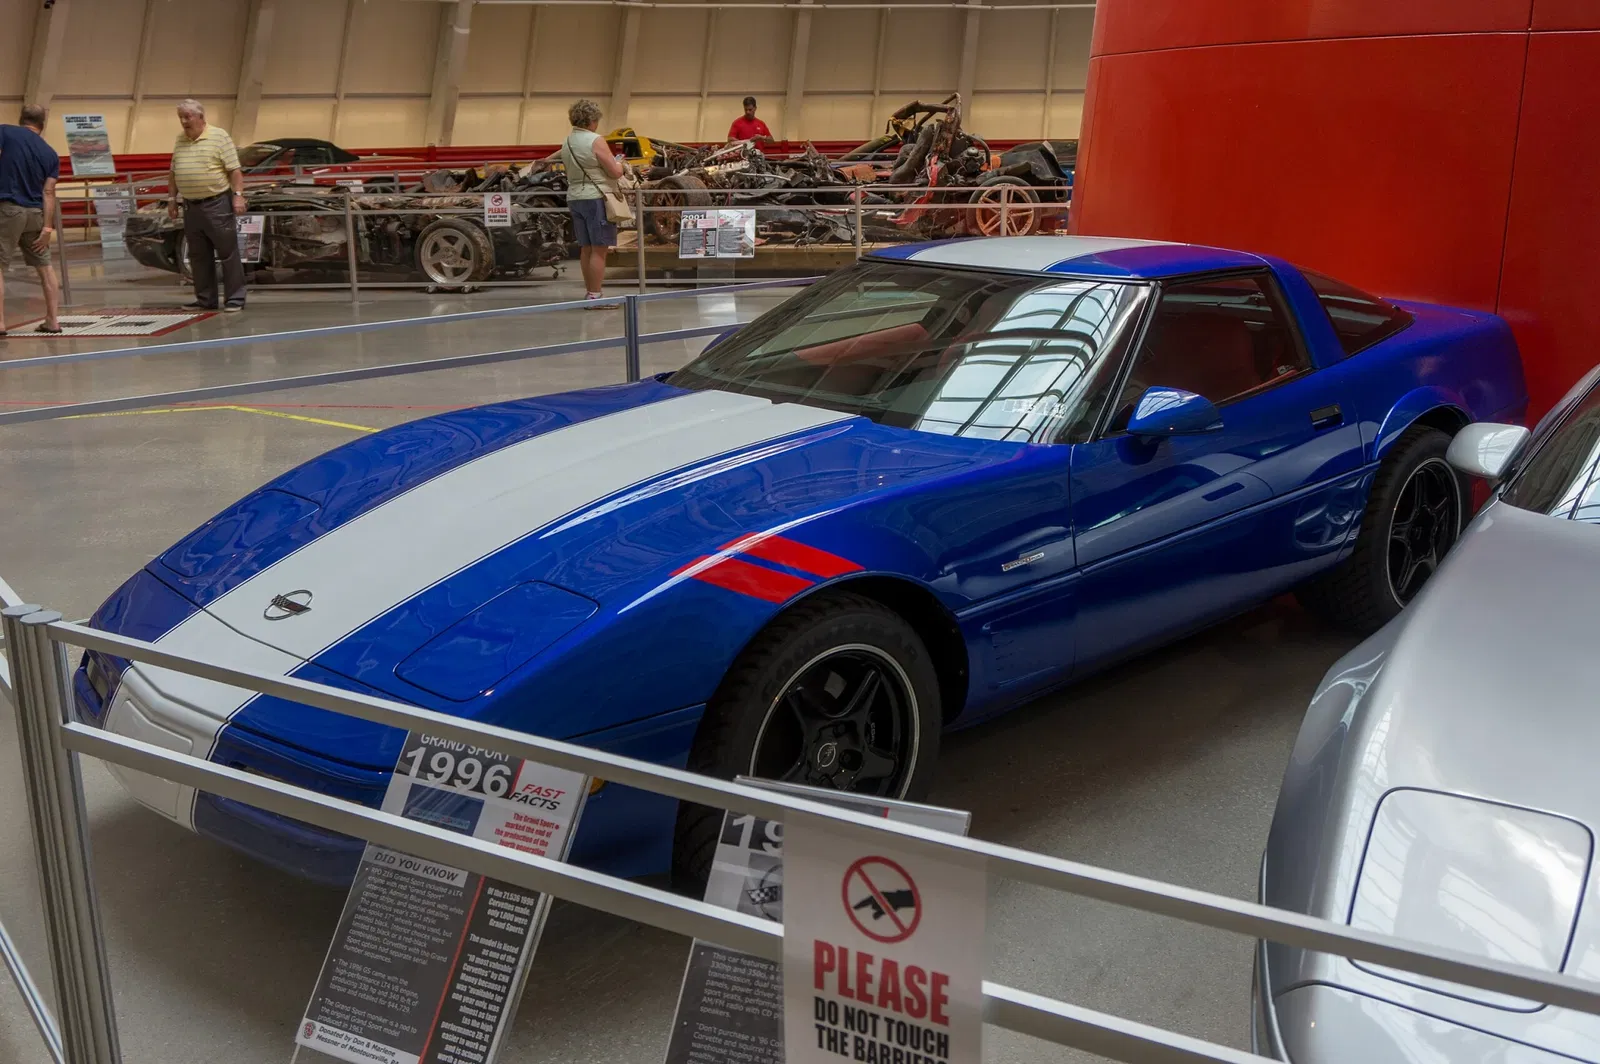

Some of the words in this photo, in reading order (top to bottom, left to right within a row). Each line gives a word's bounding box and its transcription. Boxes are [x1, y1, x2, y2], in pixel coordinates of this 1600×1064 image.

[406, 746, 512, 799] 1996
[510, 792, 560, 811] FACTS
[522, 784, 566, 799] FAST
[732, 814, 784, 857] 19
[374, 851, 396, 864] DID
[397, 858, 420, 871] YOU
[422, 865, 458, 881] KNOW
[814, 940, 949, 1026] PLEASE
[315, 1033, 340, 1047] Messner
[318, 1025, 344, 1039] Donated
[343, 1034, 352, 1042] by
[352, 1037, 365, 1047] Don
[371, 1043, 396, 1057] Marlene
[814, 996, 838, 1026] DO
[844, 1004, 880, 1038] NOT
[884, 1016, 948, 1059] TOUCH
[815, 1023, 849, 1057] THE
[854, 1035, 947, 1064] BARRI
